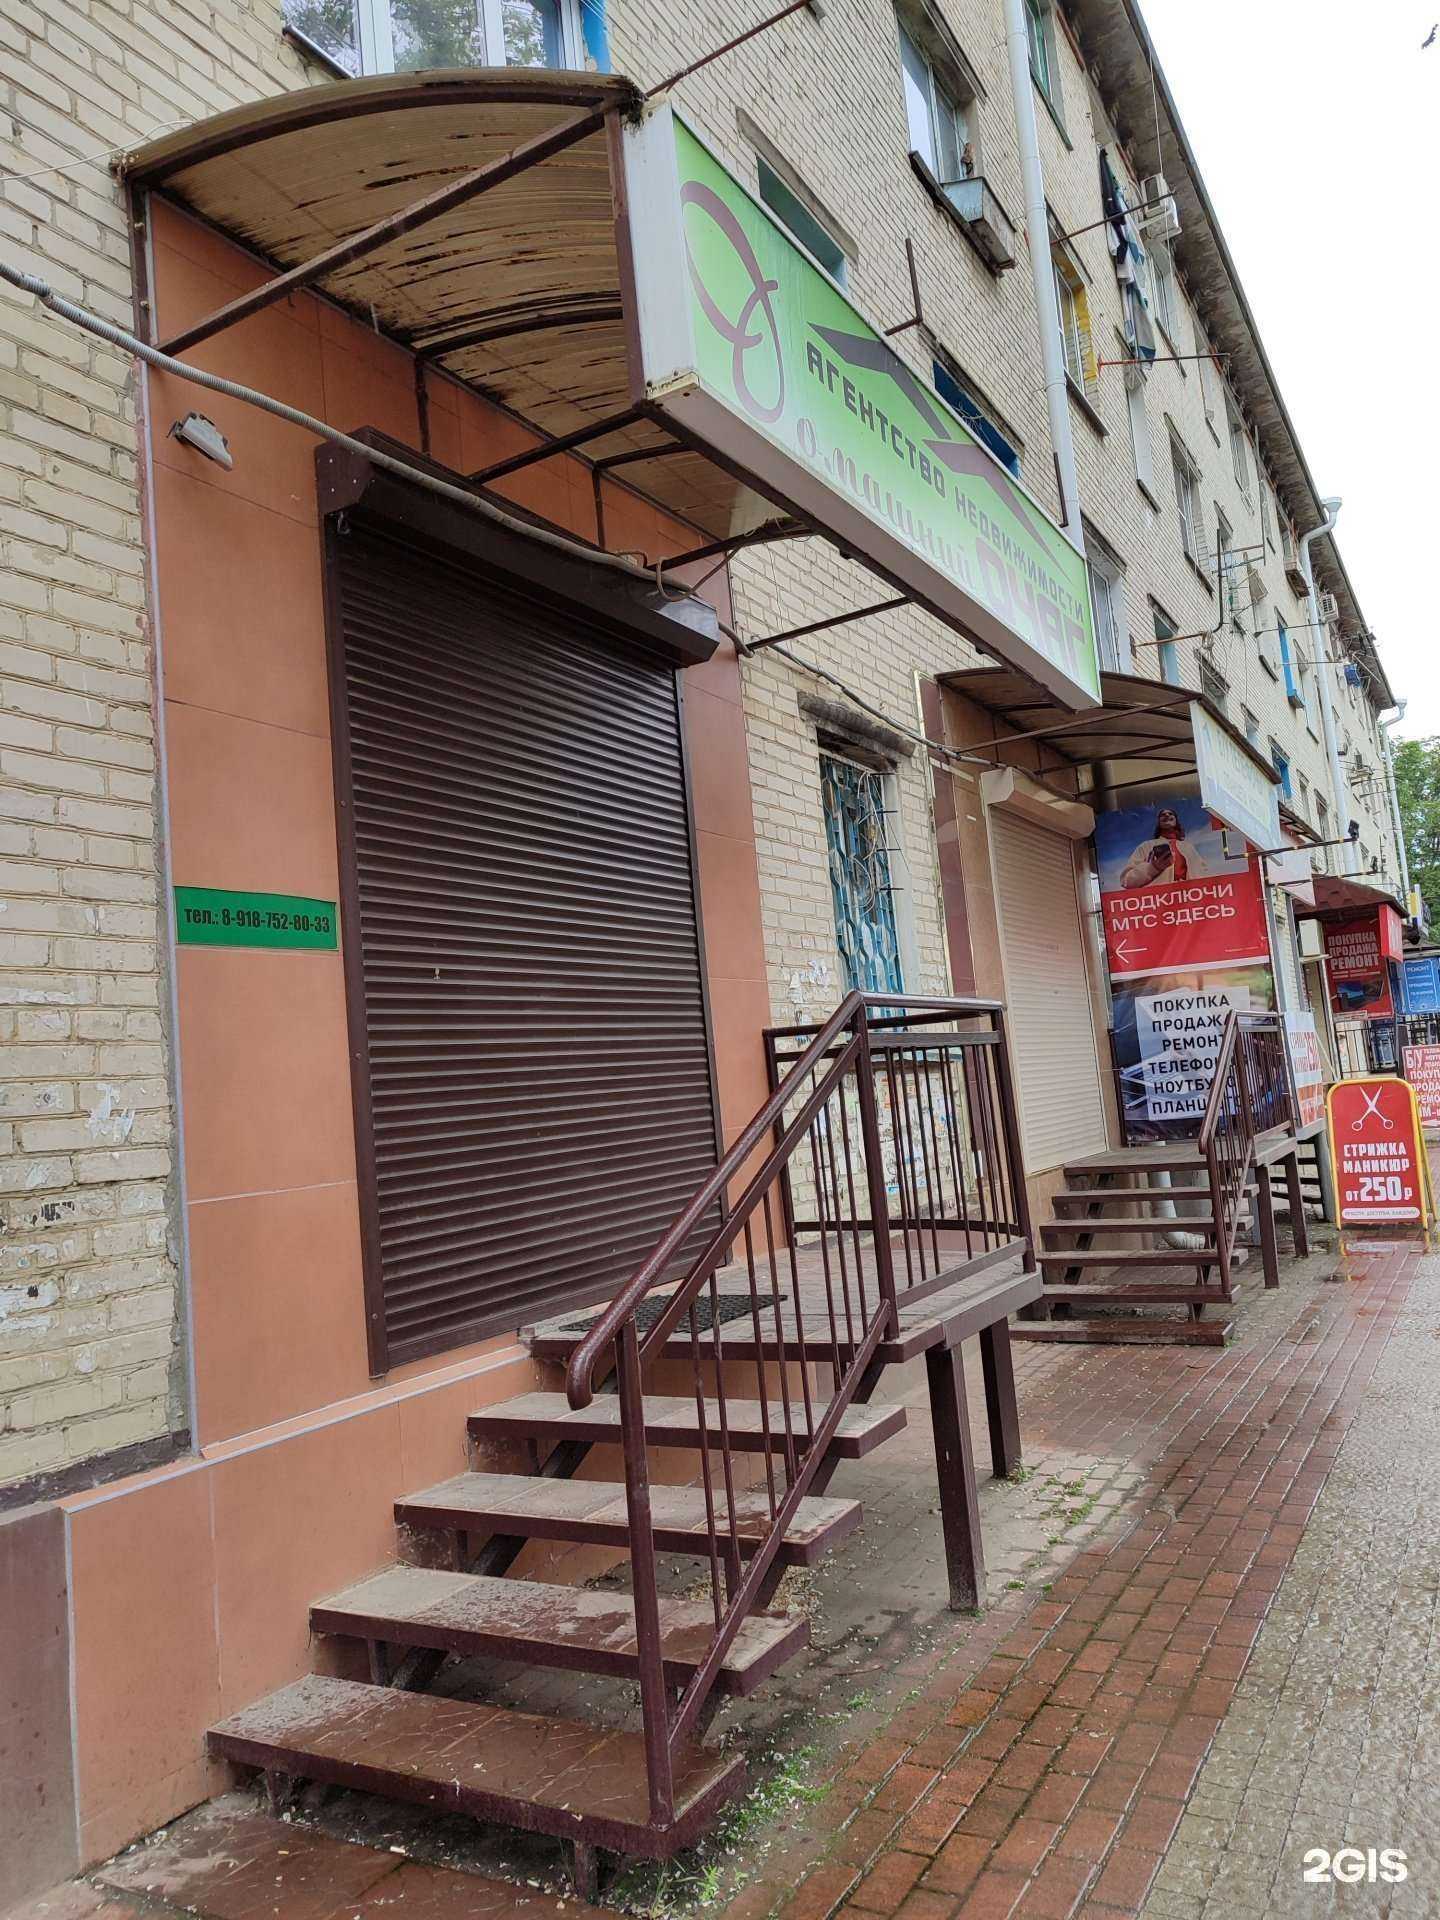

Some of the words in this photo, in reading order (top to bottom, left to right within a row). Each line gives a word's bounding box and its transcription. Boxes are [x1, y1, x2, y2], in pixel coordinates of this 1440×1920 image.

[806, 341, 946, 499] АГЕНТСТВО
[954, 486, 1085, 622] НЕДВИЖИМОСТИ
[1110, 883, 1234, 913] ПОДКЛЮЧИ
[184, 908, 218, 925] тел.:
[221, 908, 330, 933] 8-918-752-80-33
[1112, 913, 1158, 932] МТС
[1162, 903, 1236, 926] ЗДЕСЬ
[1328, 932, 1376, 946] ПОКУПКА
[1329, 943, 1378, 957] ПРОДАЖА
[1331, 954, 1379, 970] РЕМОНТ
[1153, 994, 1230, 1013] ПОКУПКА
[1152, 1014, 1229, 1032] ПРОДАЖ
[1406, 1049, 1423, 1069] Б/У
[1343, 1142, 1407, 1157] СТРИЖКА
[1343, 1158, 1410, 1173] МАНИКЮР
